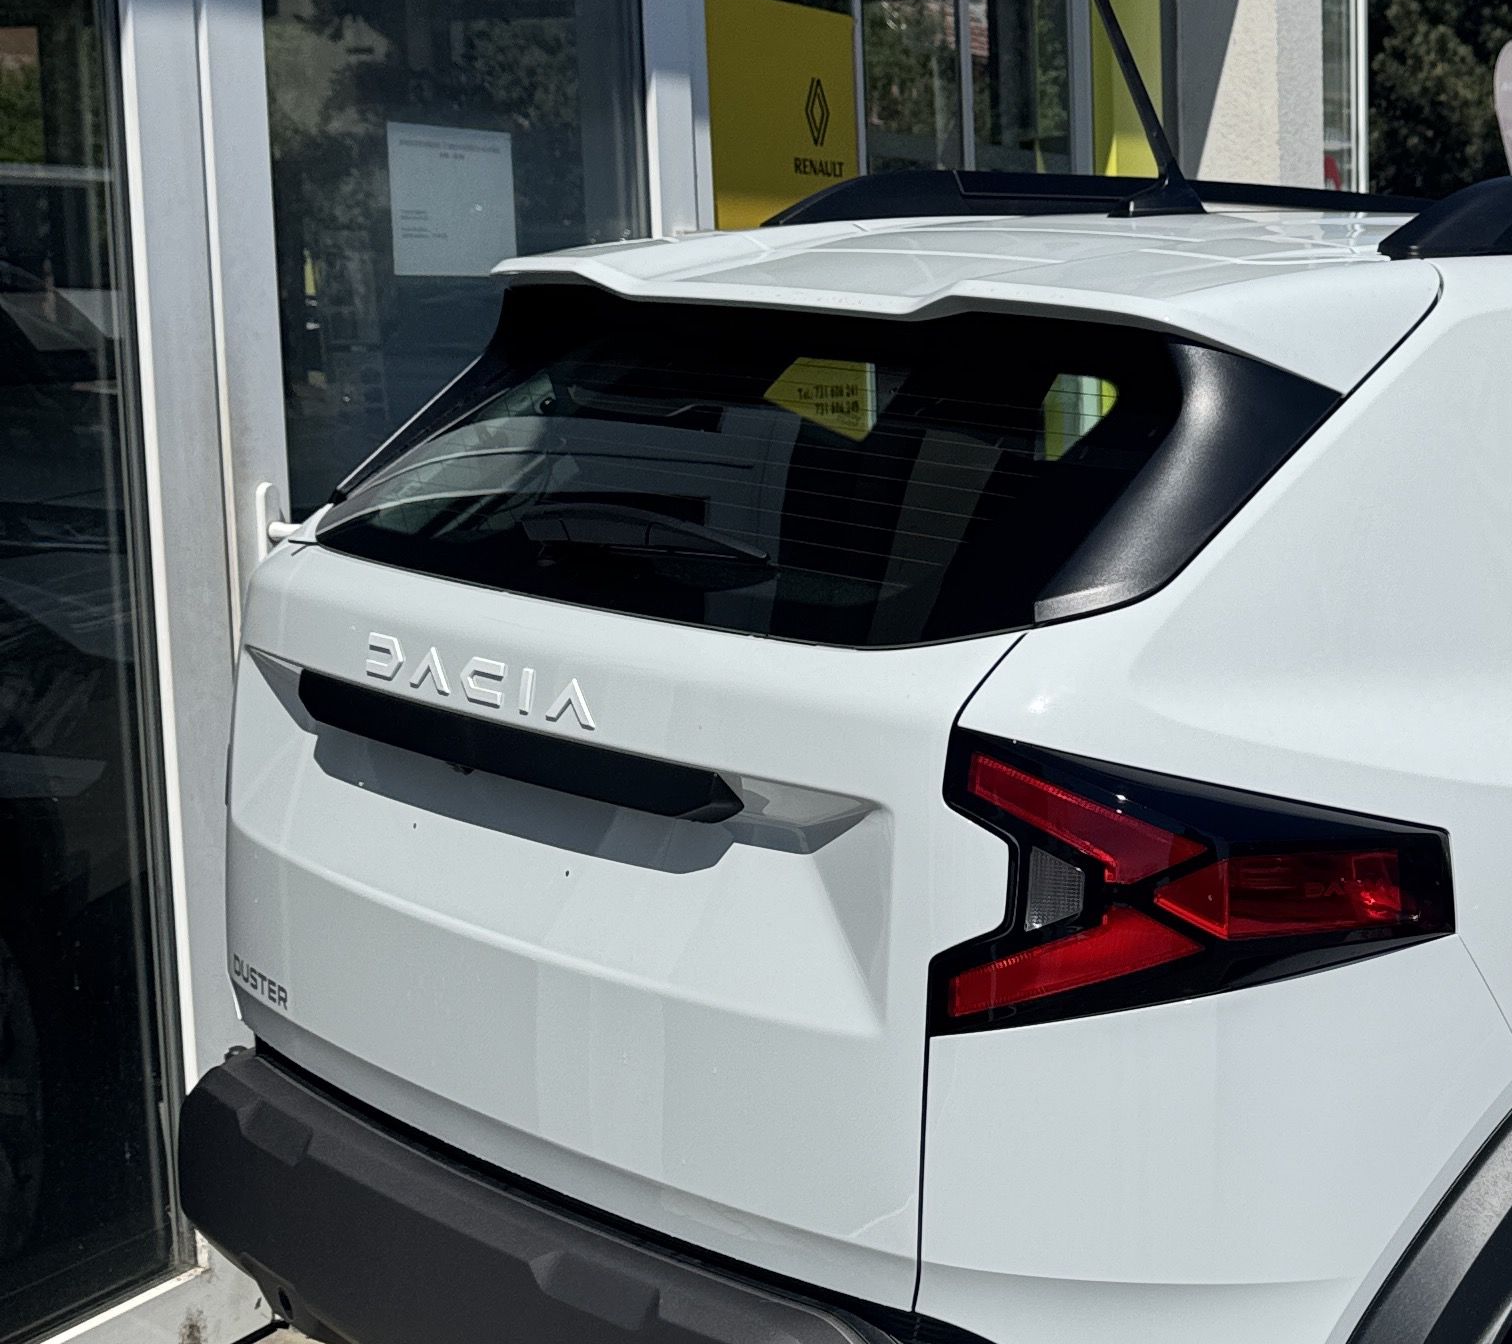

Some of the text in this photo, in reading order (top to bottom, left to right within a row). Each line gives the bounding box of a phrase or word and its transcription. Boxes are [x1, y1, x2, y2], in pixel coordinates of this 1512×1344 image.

[794, 157, 844, 177] RENAULT
[366, 631, 596, 731] DACIA
[233, 953, 288, 1011] DUSTER
